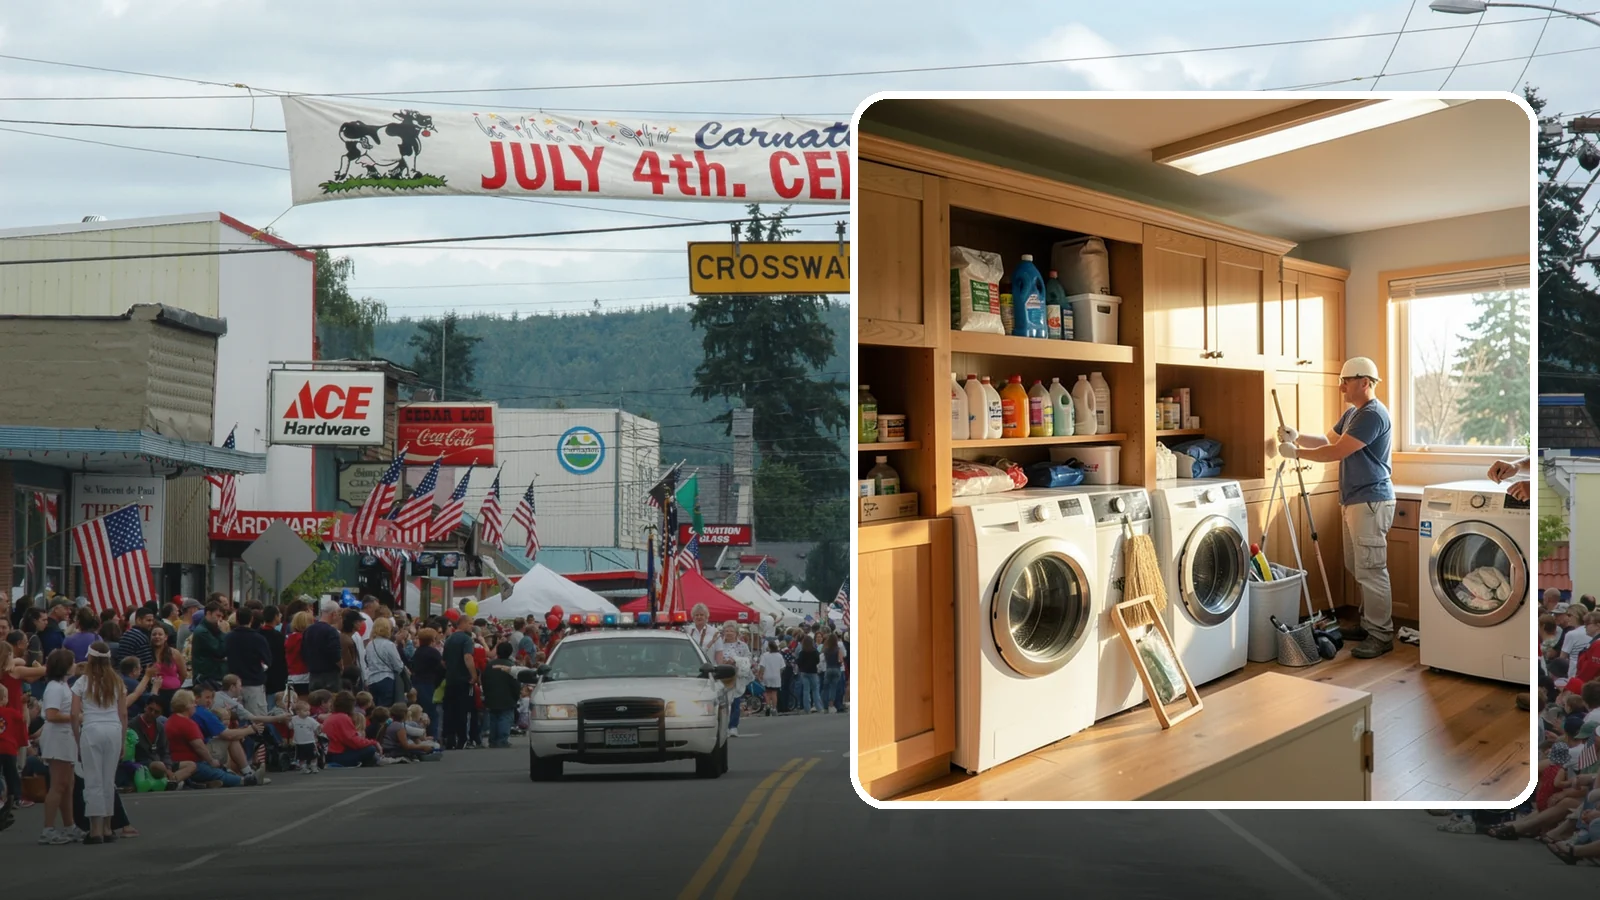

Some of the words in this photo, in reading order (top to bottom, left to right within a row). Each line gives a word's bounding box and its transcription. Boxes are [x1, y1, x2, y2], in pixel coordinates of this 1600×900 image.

[695, 121, 850, 149] Carnat
[481, 141, 604, 192] JULY
[632, 150, 746, 198] 4th.
[697, 254, 850, 280] CROSSWA
[283, 380, 373, 420] ACE
[406, 409, 453, 422] CEDAR
[283, 421, 370, 436] Hardware
[417, 428, 476, 447] Coca-Cola
[354, 467, 384, 480] Simpl
[83, 484, 93, 494] St.
[95, 485, 124, 495] Vincent
[126, 486, 136, 495] de
[137, 486, 155, 495] Paul
[81, 503, 153, 522] THT
[213, 516, 330, 534] HARDARE
[688, 526, 741, 535] CRNATION
[699, 535, 730, 543] GLASS
